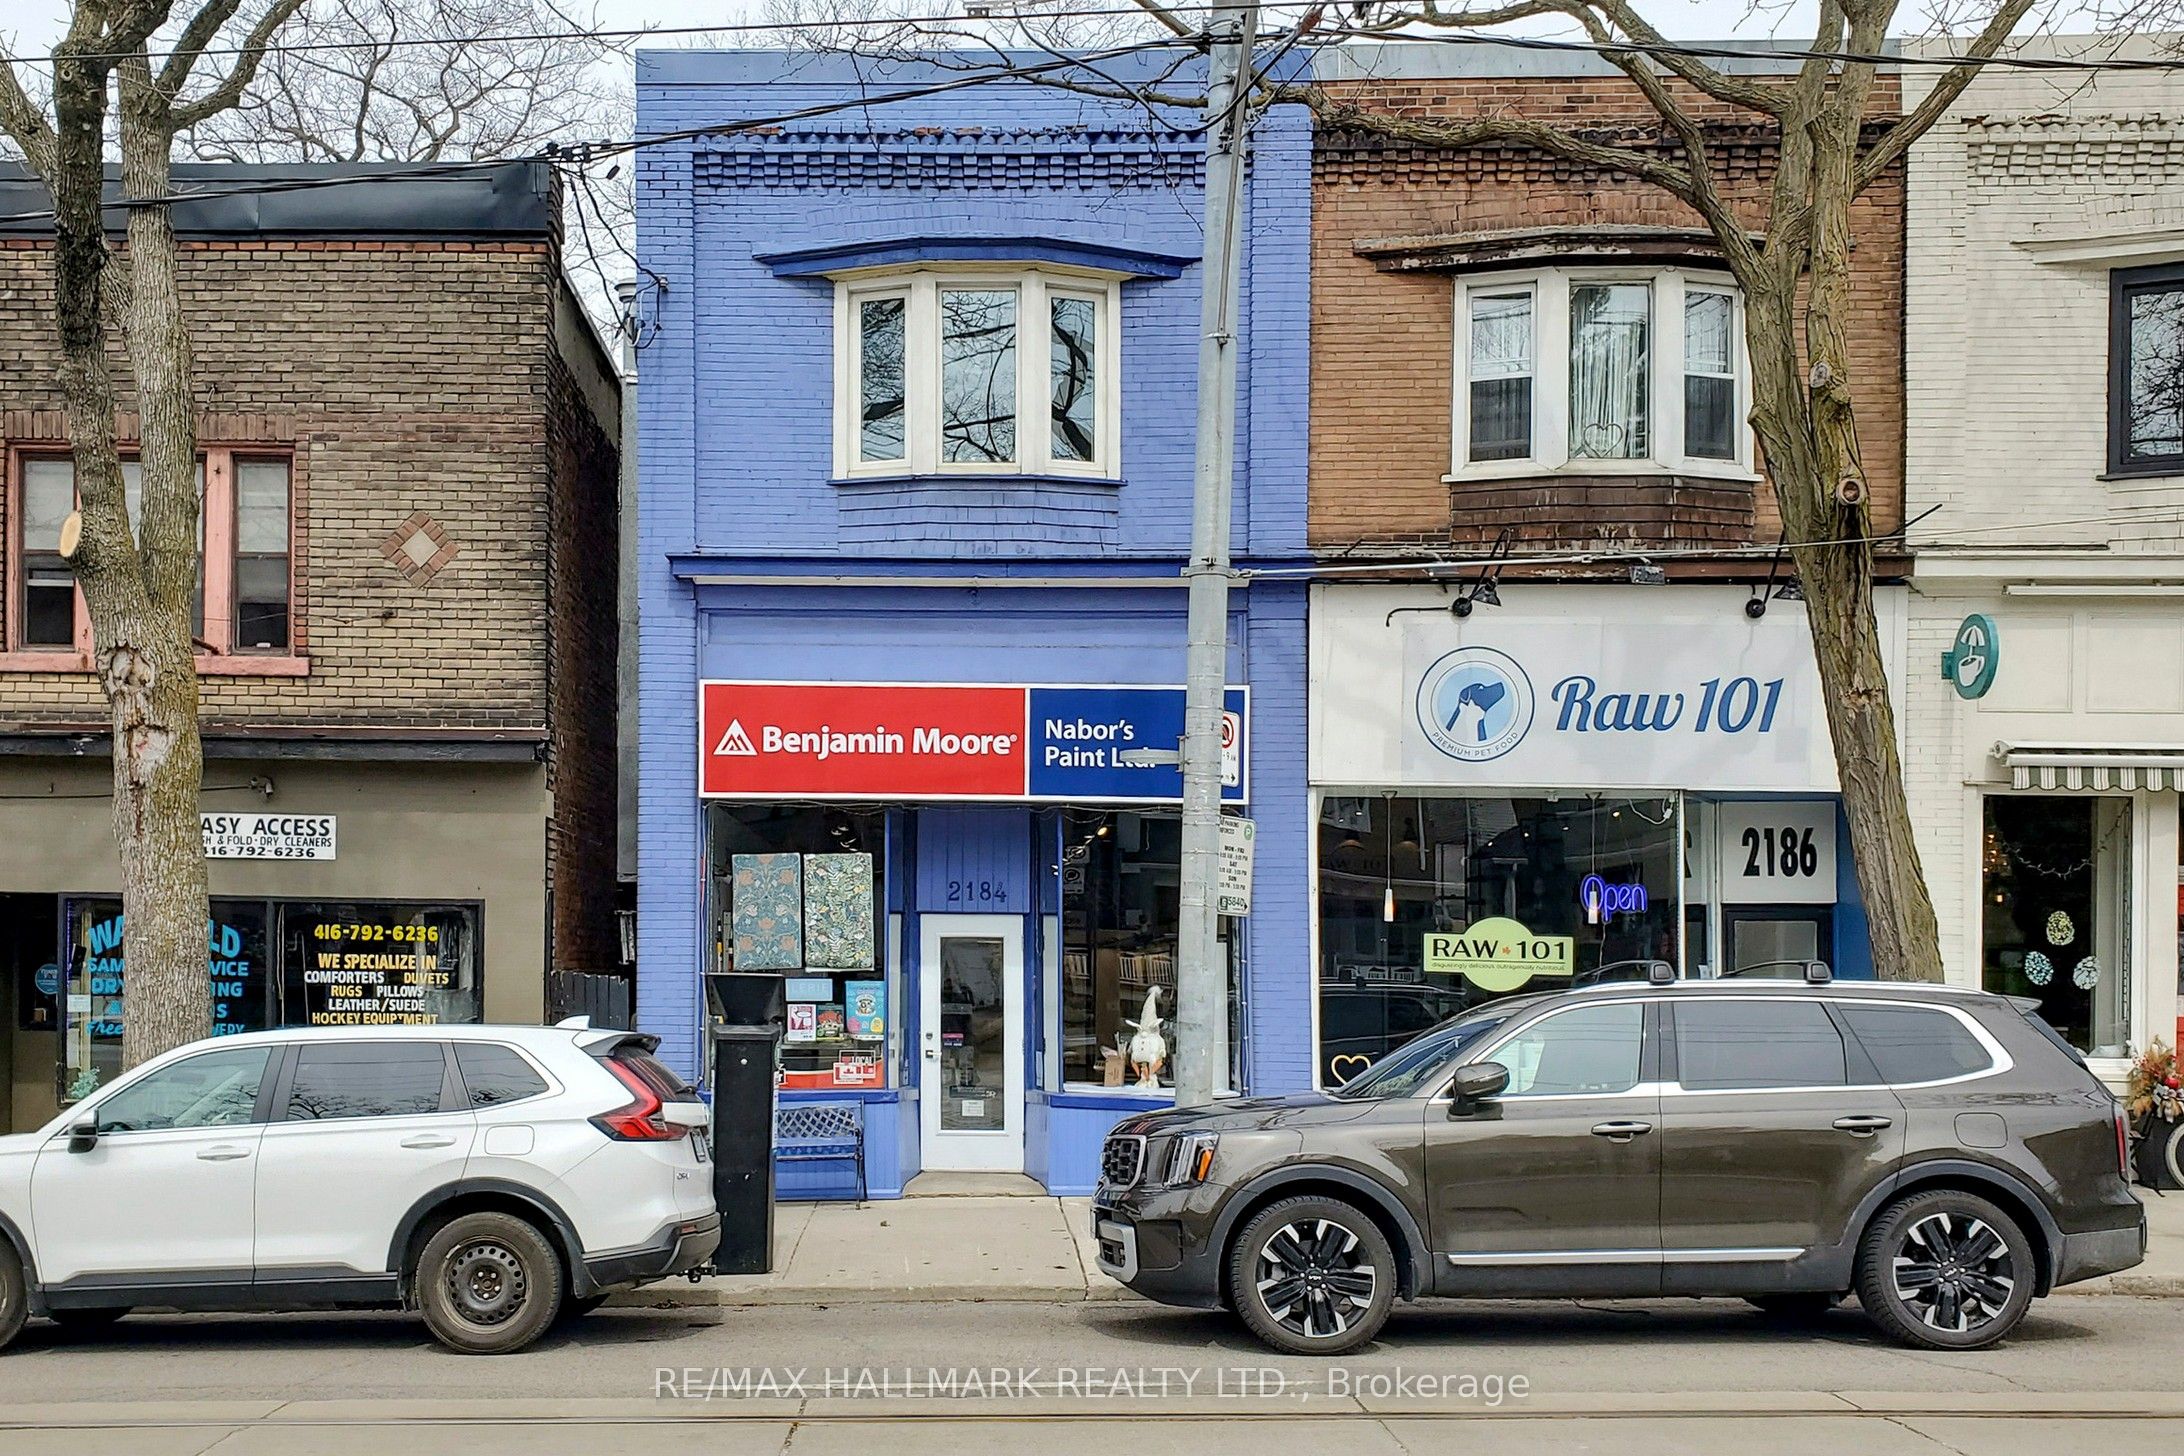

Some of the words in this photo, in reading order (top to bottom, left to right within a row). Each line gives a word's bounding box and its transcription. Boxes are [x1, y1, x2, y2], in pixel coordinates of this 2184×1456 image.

[1551, 675, 1685, 732] Raw
[1694, 676, 1784, 733] 101
[1045, 718, 1135, 740] Nabor's
[762, 725, 904, 760] Benjamin
[1433, 731, 1471, 757] PREMIUM
[1475, 748, 1492, 757] PET
[1495, 732, 1518, 752] FOOD
[1045, 746, 1106, 767] Paint
[201, 817, 241, 834] ASY
[252, 818, 330, 837] ACCESS
[217, 836, 224, 845] &
[227, 835, 253, 846] FOLD
[260, 836, 279, 847] DRY
[285, 837, 332, 848] CLEANERS
[1742, 827, 1818, 877] 2186
[948, 881, 1007, 903] 2184
[1581, 874, 1647, 923] Open
[314, 924, 439, 942] 416-792-6236
[1432, 938, 1499, 959] RAW
[1516, 940, 1565, 960] 101
[87, 957, 125, 973] SAM
[209, 961, 249, 977] VICE
[318, 953, 341, 968] WE
[344, 953, 416, 970] SPECIALIZE
[421, 955, 437, 970] IN
[304, 971, 385, 984] COMFORTERS
[403, 972, 449, 985] DUVETS
[331, 985, 363, 997] RUGS
[377, 985, 424, 998] PILLOWS
[328, 998, 426, 1012] LEATHER/SUEDE
[312, 1012, 361, 1025] HOCKEY
